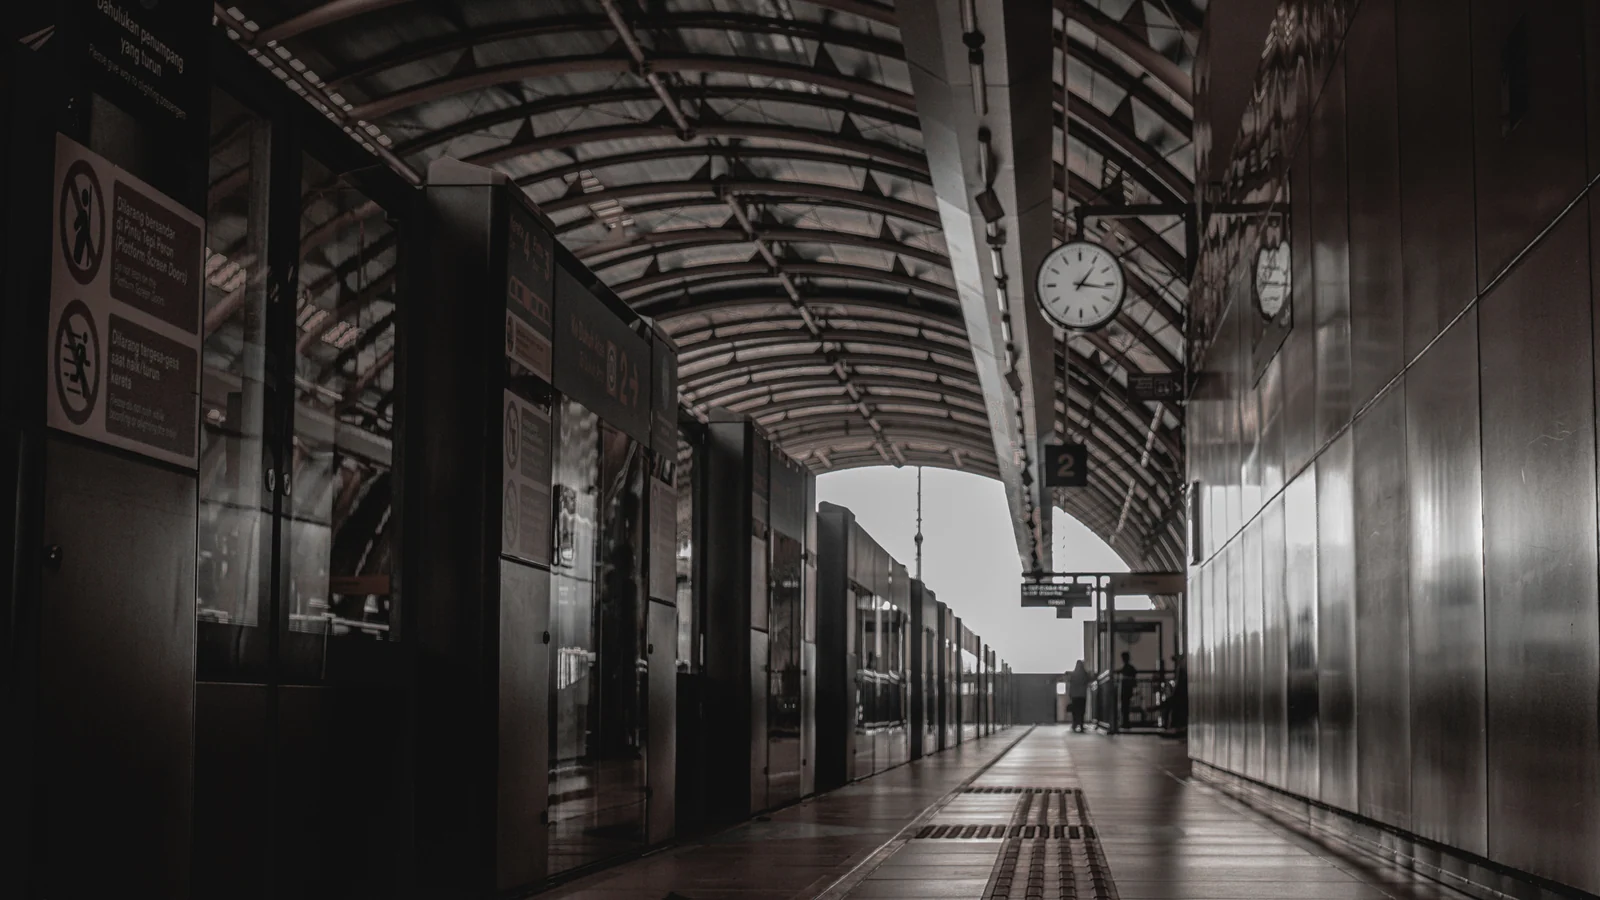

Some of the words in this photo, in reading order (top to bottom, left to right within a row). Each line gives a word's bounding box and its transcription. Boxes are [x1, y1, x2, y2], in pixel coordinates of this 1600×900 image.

[97, 0, 140, 36] Dahulukan
[141, 28, 184, 74] penumpang
[120, 37, 140, 65] yang
[141, 50, 162, 77] turun
[116, 215, 123, 230] di
[124, 219, 141, 241] Pintu
[142, 229, 156, 253] Tepi
[117, 196, 144, 227] Dilarang
[145, 211, 176, 240] bersandar
[115, 234, 145, 263] (Platform
[146, 251, 167, 273] Screen
[111, 352, 125, 368] saat
[112, 329, 139, 357] Dilarang
[140, 341, 180, 370] tergesa-gesa
[111, 368, 132, 390] kereta
[620, 350, 628, 406] 2
[1057, 453, 1075, 477] 2
